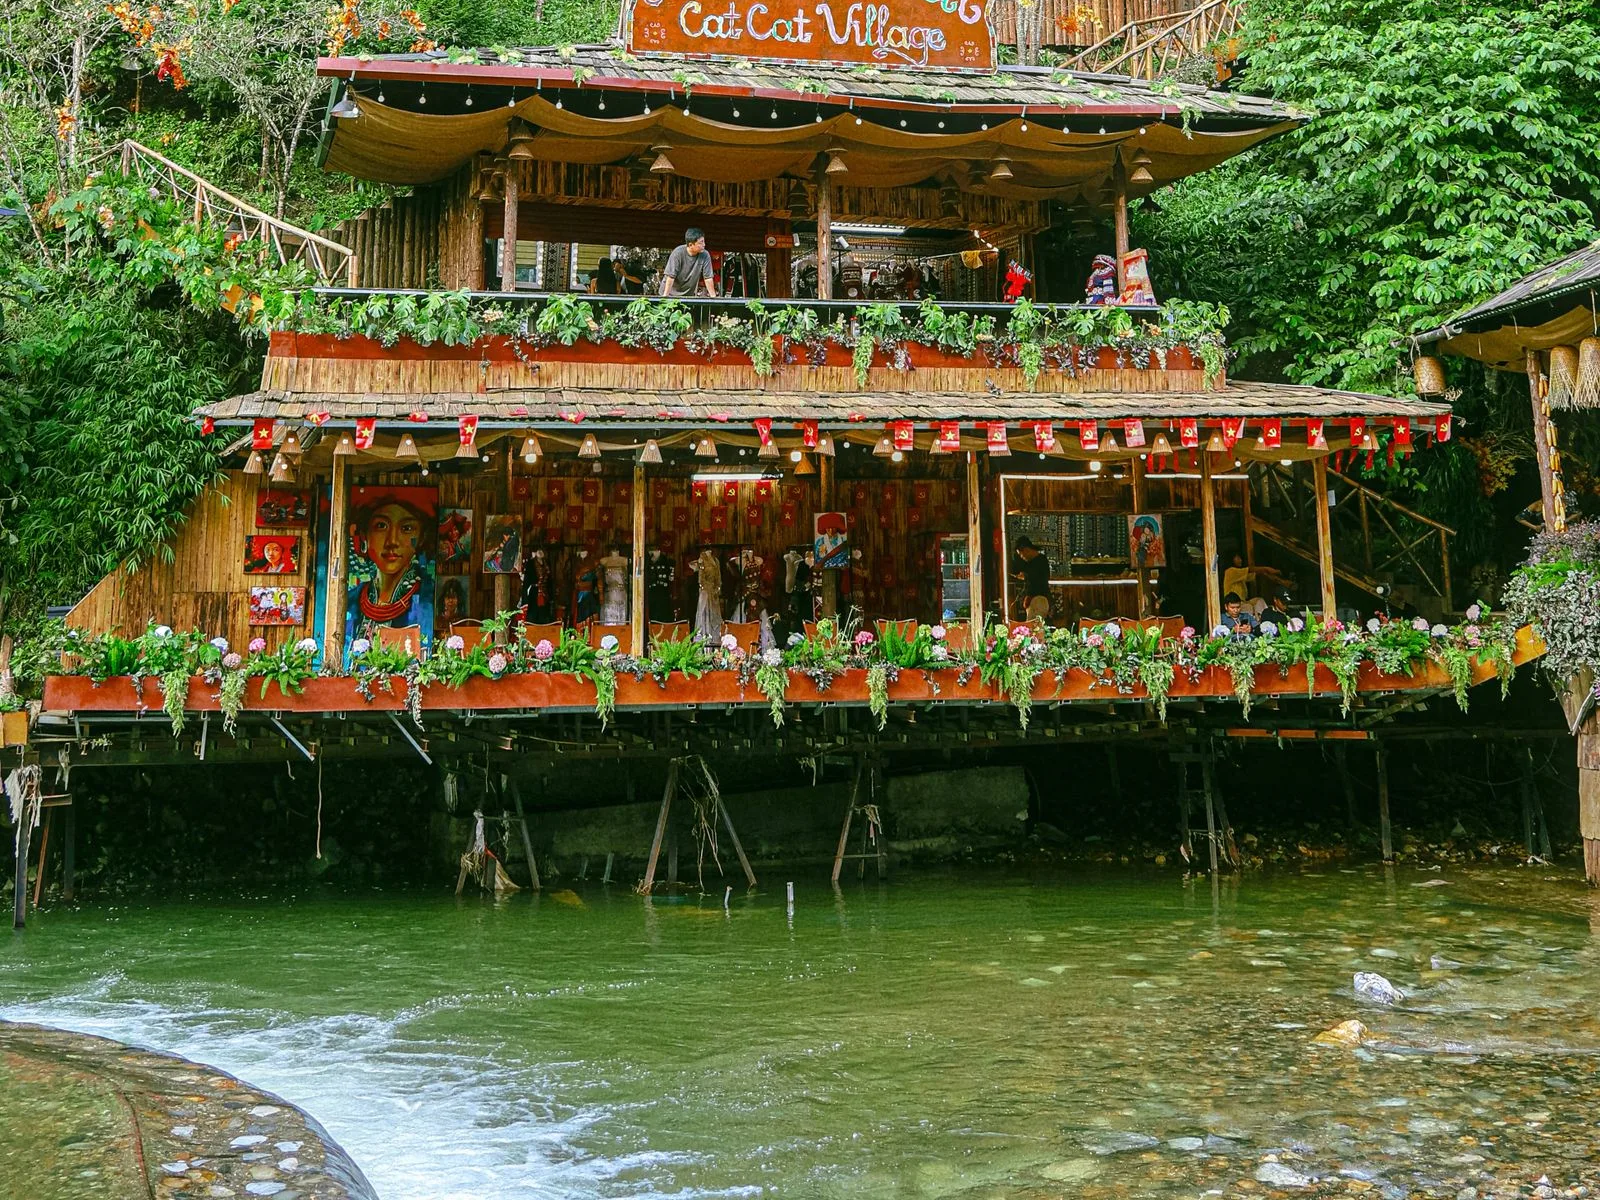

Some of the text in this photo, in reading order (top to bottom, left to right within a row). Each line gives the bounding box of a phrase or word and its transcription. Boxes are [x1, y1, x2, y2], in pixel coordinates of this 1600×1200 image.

[679, 0, 947, 67] Cat Cat Village
